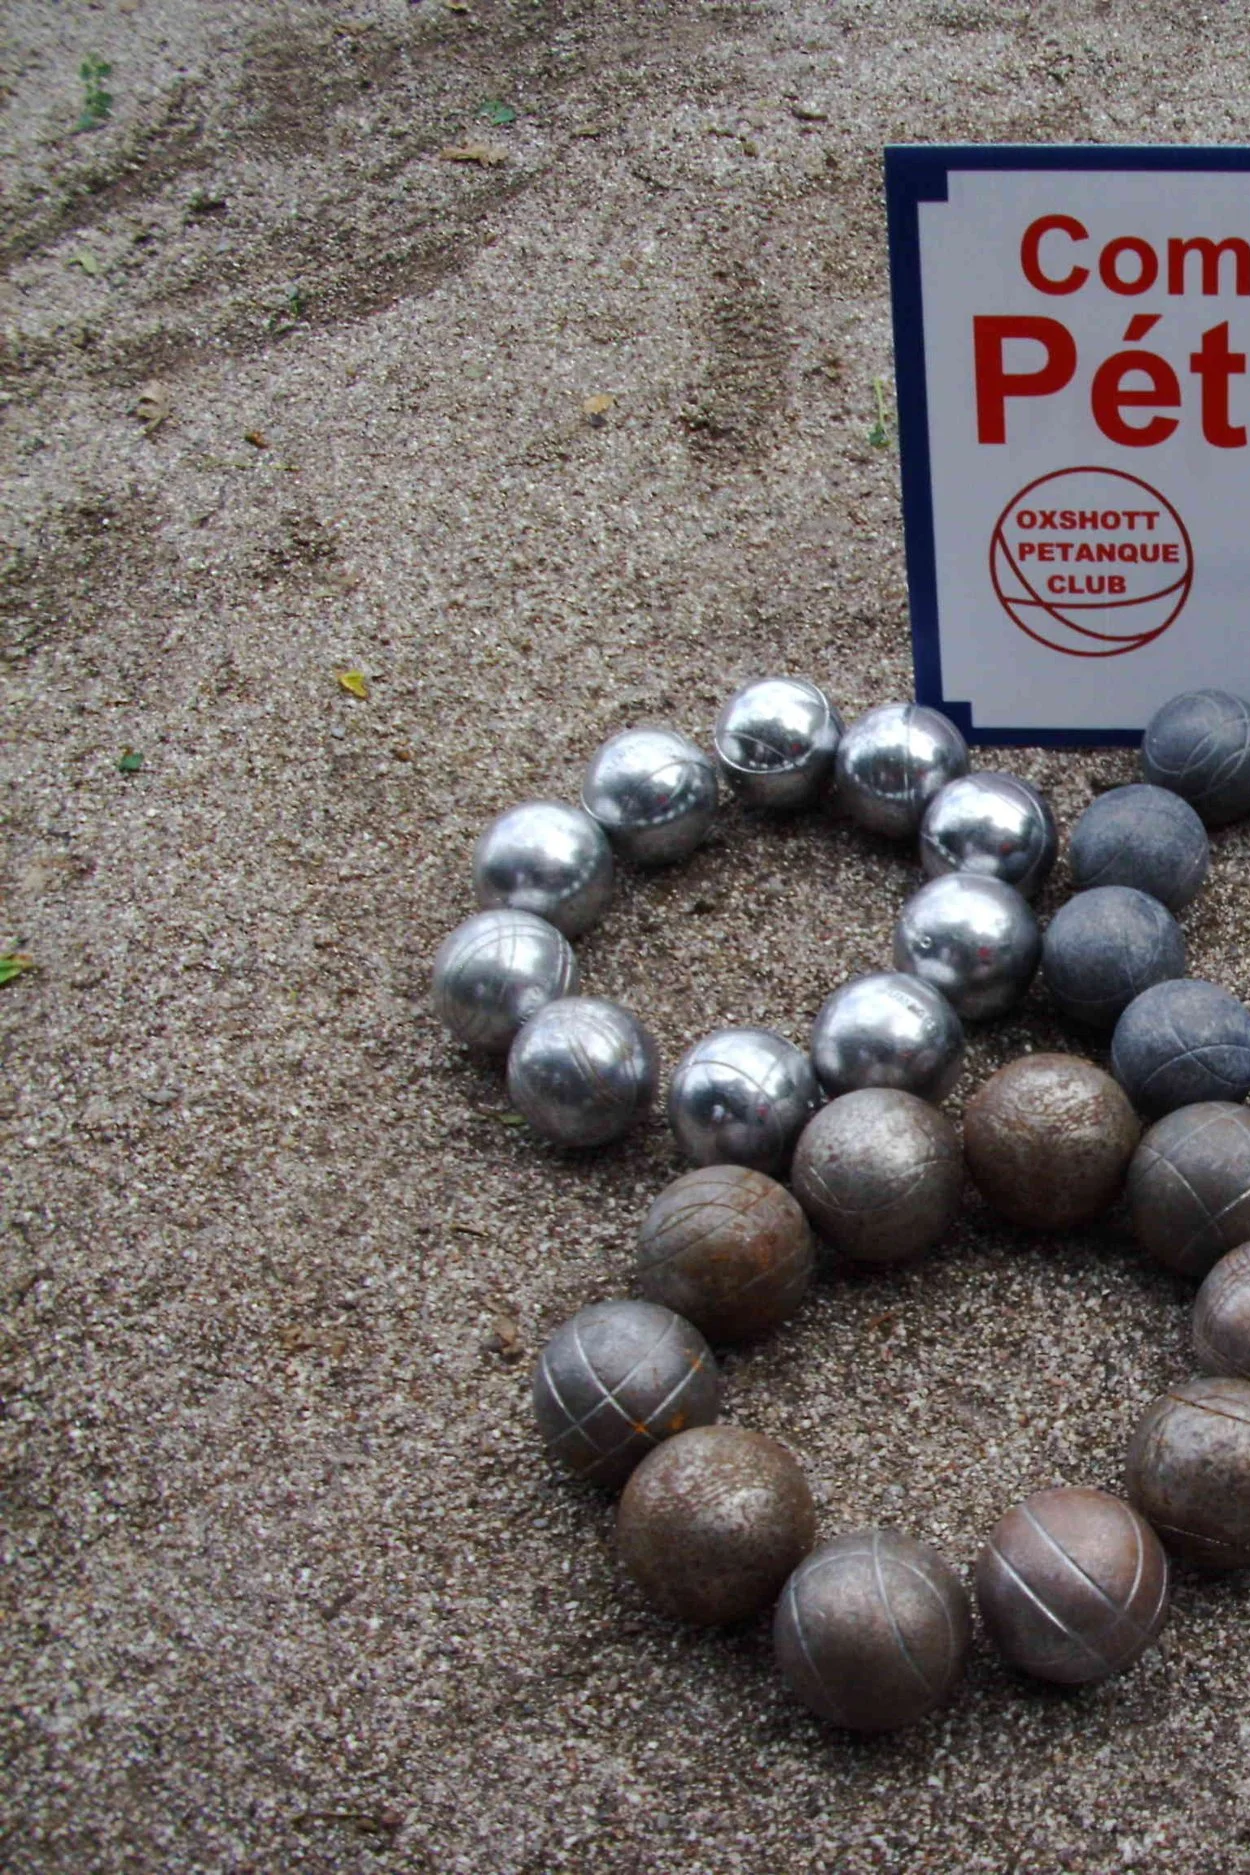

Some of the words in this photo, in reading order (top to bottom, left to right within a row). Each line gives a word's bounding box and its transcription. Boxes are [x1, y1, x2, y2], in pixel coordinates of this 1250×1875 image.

[1016, 509, 1160, 531] OXSHOTT
[1018, 541, 1181, 564] PETANQUE
[1046, 574, 1127, 595] CLUB
